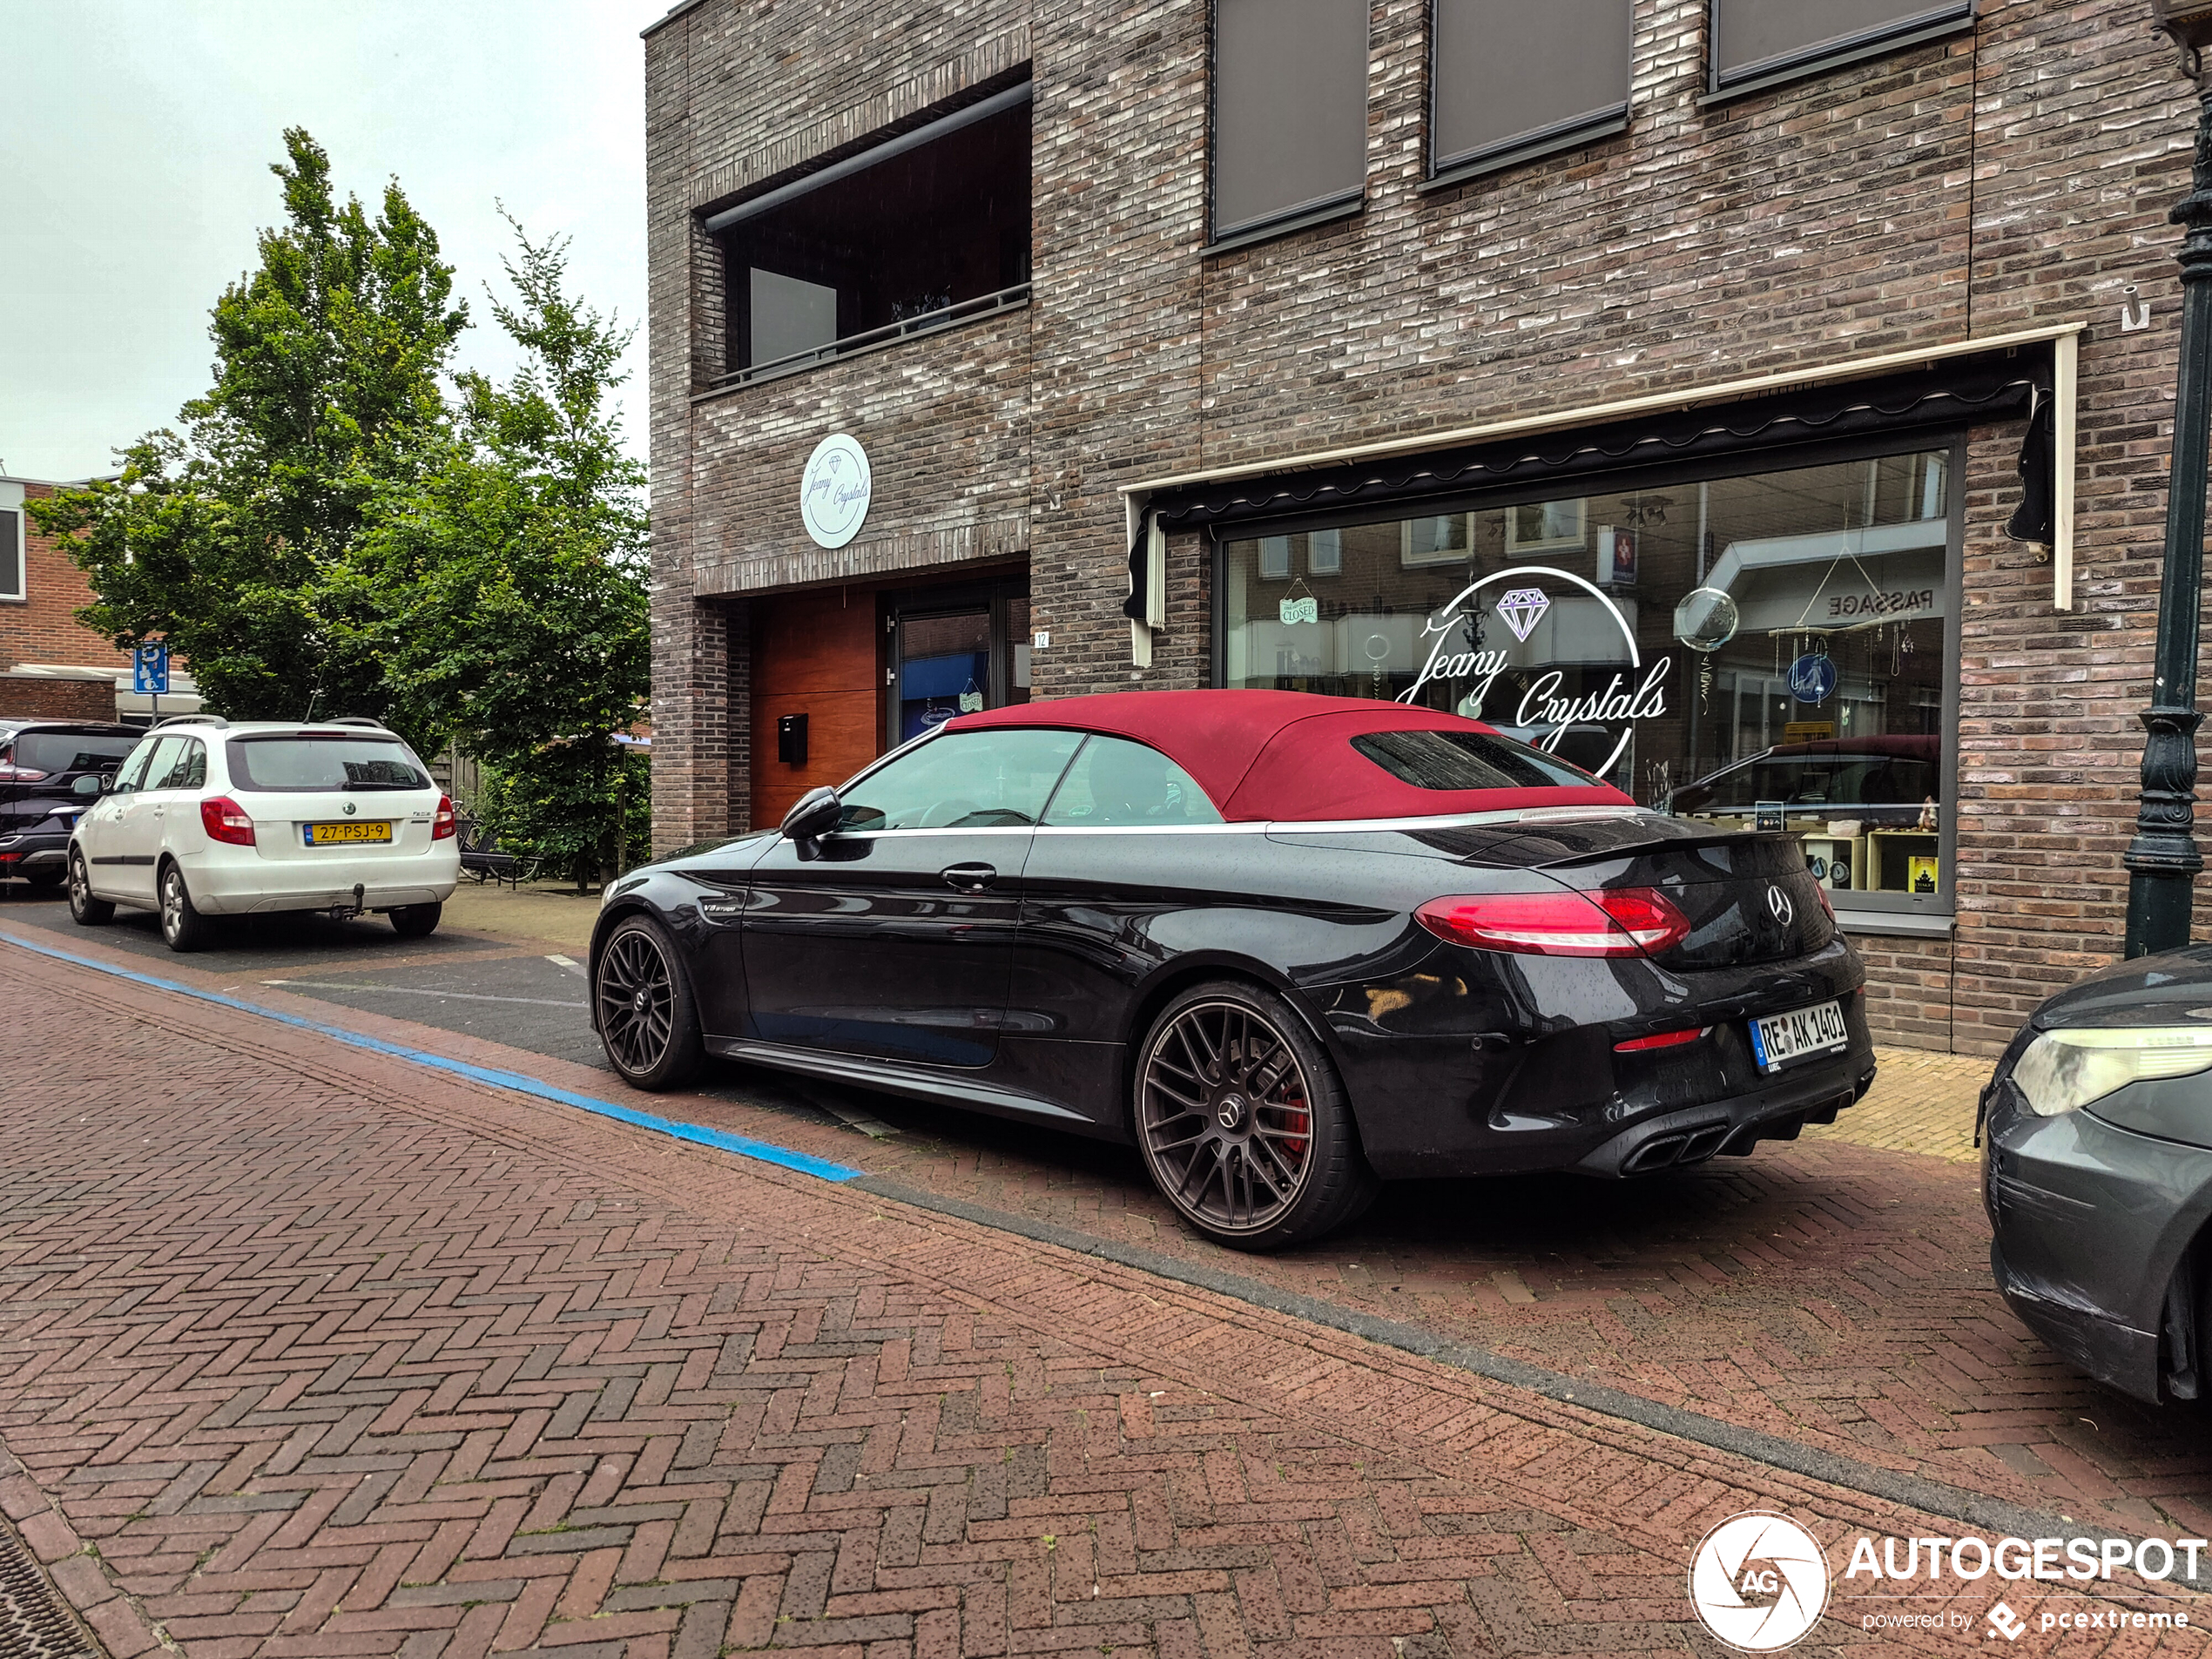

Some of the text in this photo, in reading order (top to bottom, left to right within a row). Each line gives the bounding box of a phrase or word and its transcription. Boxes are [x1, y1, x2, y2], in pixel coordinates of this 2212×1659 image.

[803, 466, 869, 514] Jeany Crystals
[1283, 605, 1314, 621] CLOSED
[1038, 633, 1047, 647] 12
[1395, 617, 1671, 753] Jeany Crystals
[961, 698, 981, 710] CLOSED
[320, 825, 384, 840] 27-PSJ-9
[1760, 1005, 1845, 1058] RE AK 1401
[1757, 1047, 1764, 1058] D
